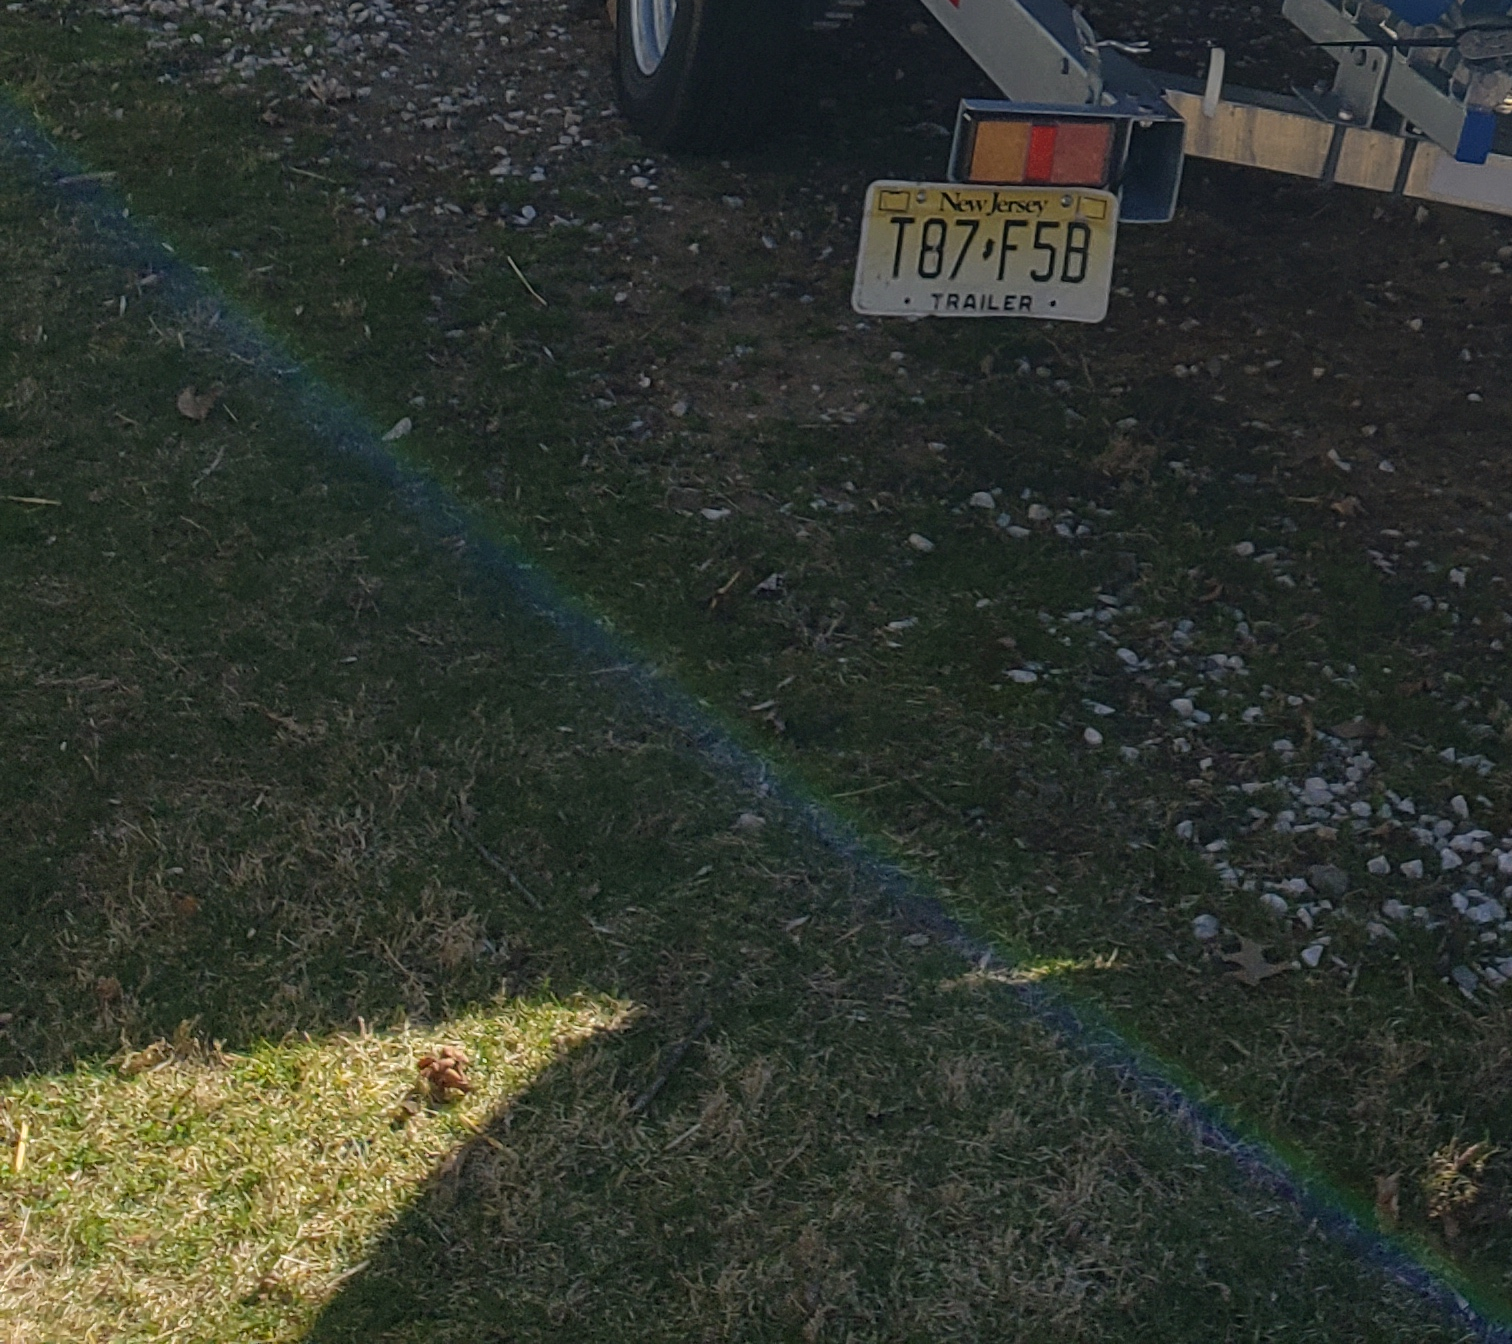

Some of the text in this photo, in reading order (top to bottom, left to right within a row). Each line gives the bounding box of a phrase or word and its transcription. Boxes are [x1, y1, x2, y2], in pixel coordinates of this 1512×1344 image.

[940, 192, 1049, 217] New Jersey
[931, 293, 1033, 311] TRAILER
